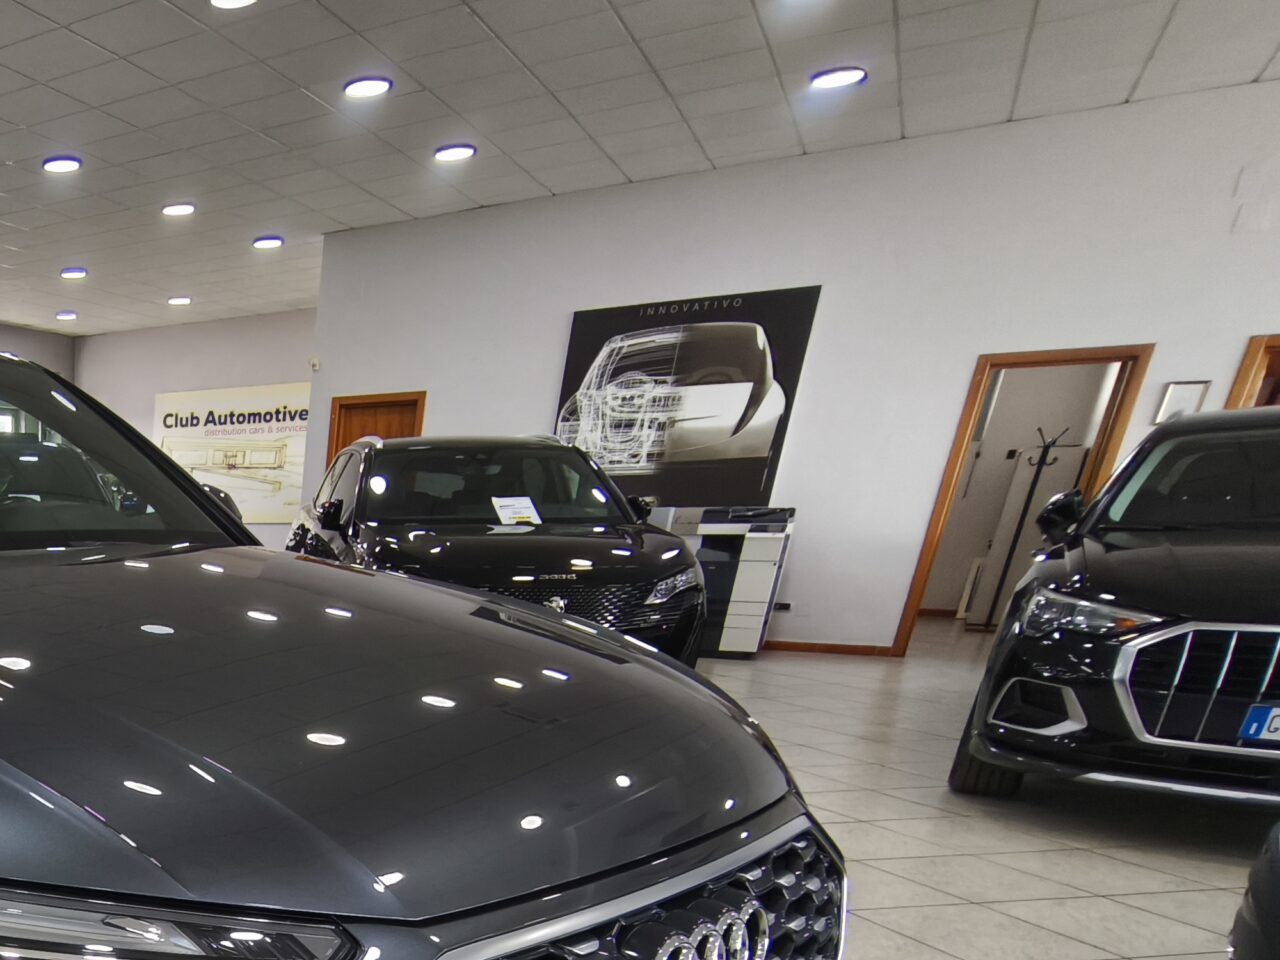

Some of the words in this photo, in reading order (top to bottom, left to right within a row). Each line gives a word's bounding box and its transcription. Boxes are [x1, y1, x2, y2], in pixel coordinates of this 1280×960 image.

[640, 298, 742, 316] INNOVATIVO
[163, 412, 200, 429] Club
[204, 405, 309, 426] Automotive
[204, 428, 247, 437] distribution
